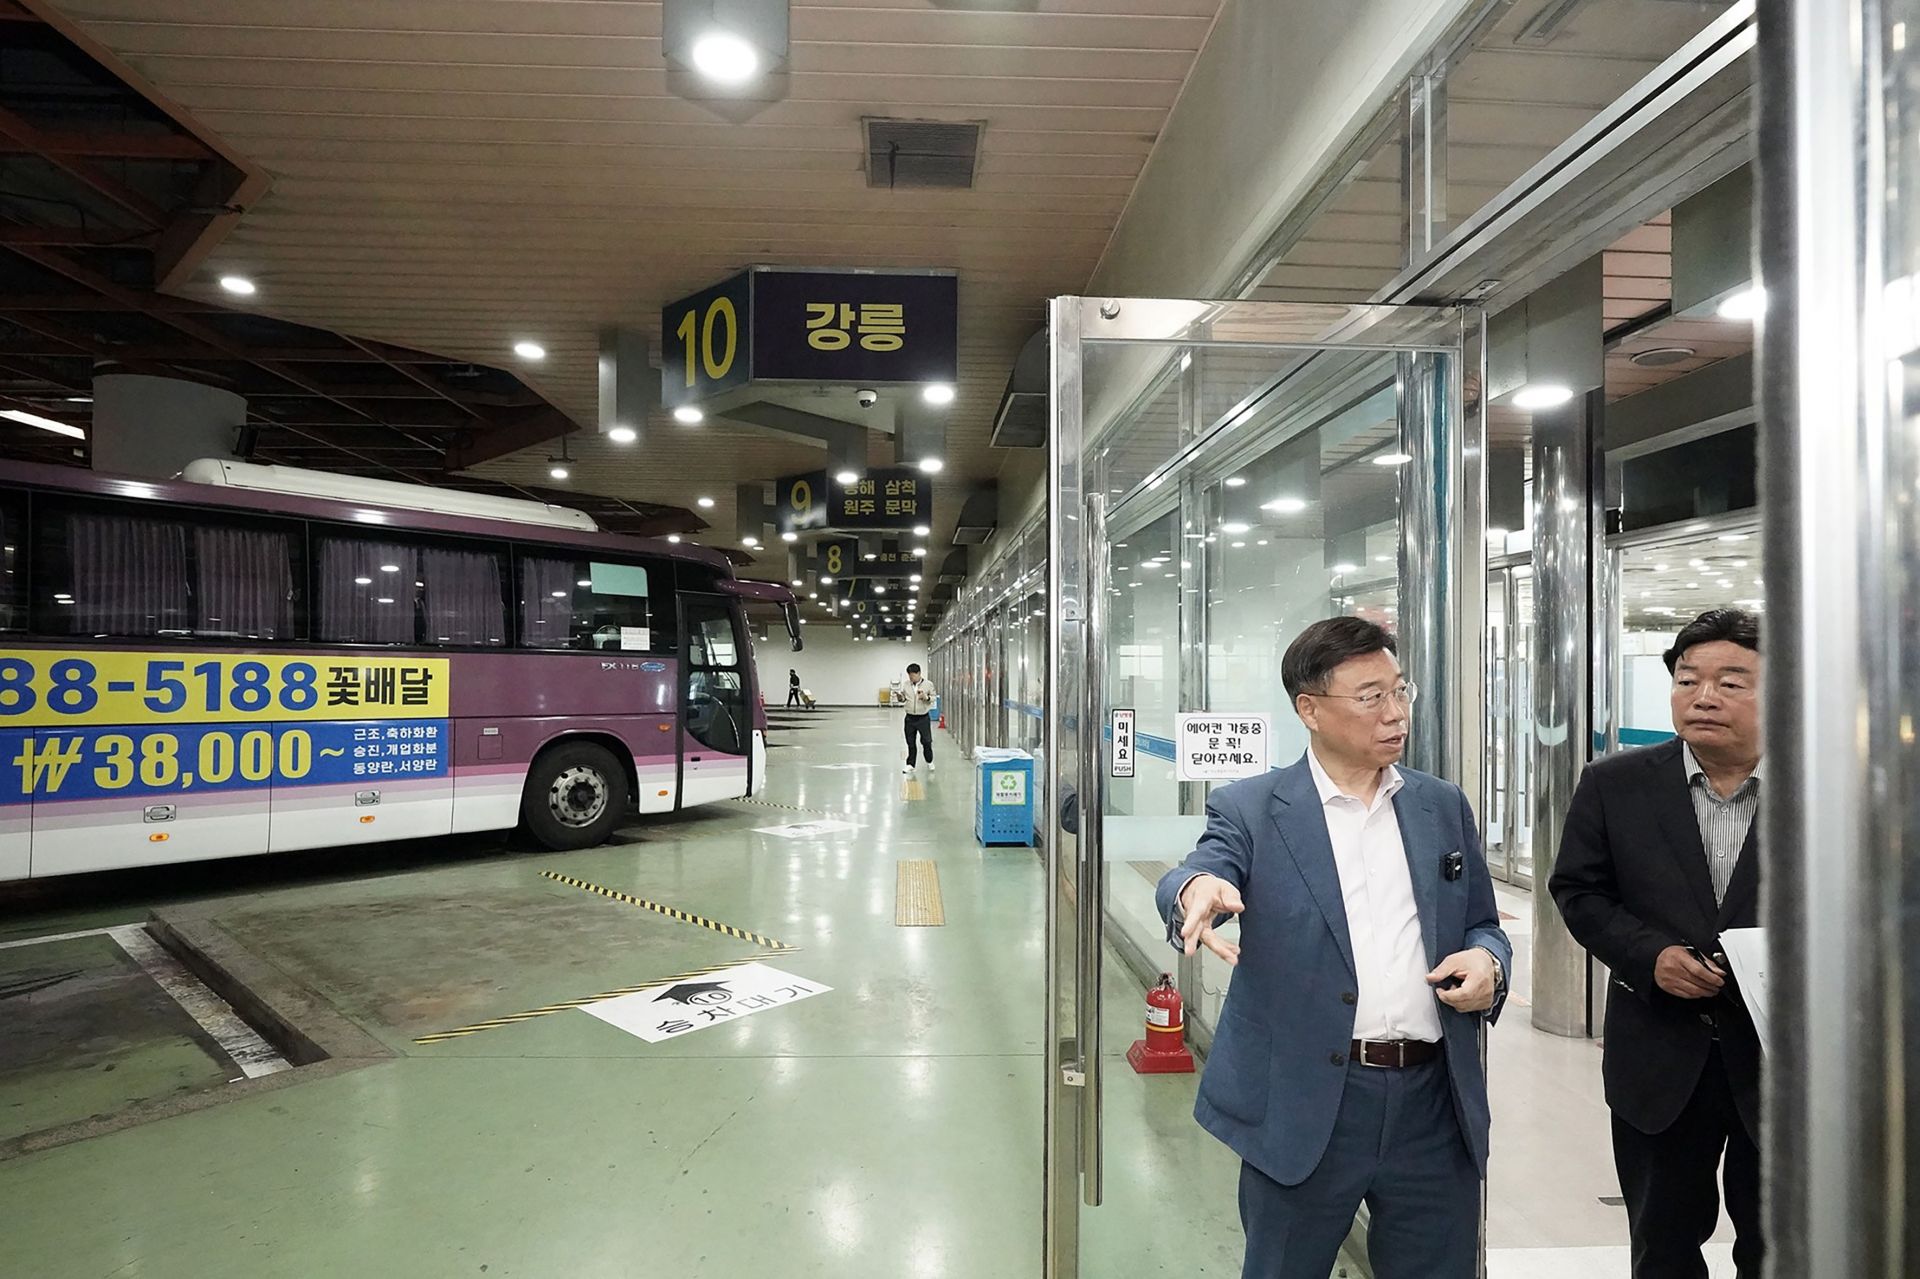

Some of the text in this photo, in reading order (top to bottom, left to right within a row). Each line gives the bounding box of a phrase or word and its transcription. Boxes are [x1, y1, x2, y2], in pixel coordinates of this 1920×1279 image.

[805, 303, 906, 351] 강릉
[676, 296, 738, 388] 10
[885, 480, 917, 495] 삼척
[790, 480, 812, 525] 9
[843, 499, 917, 515] 원주 문막
[827, 545, 841, 574] 8
[0, 657, 433, 716] 88-5188 꽃배달
[1117, 721, 1129, 760] 미세요
[1186, 722, 1262, 734] 에어컨 가동중
[1208, 737, 1241, 750] 문 꼭!
[1191, 752, 1259, 765] 닫아주세요.
